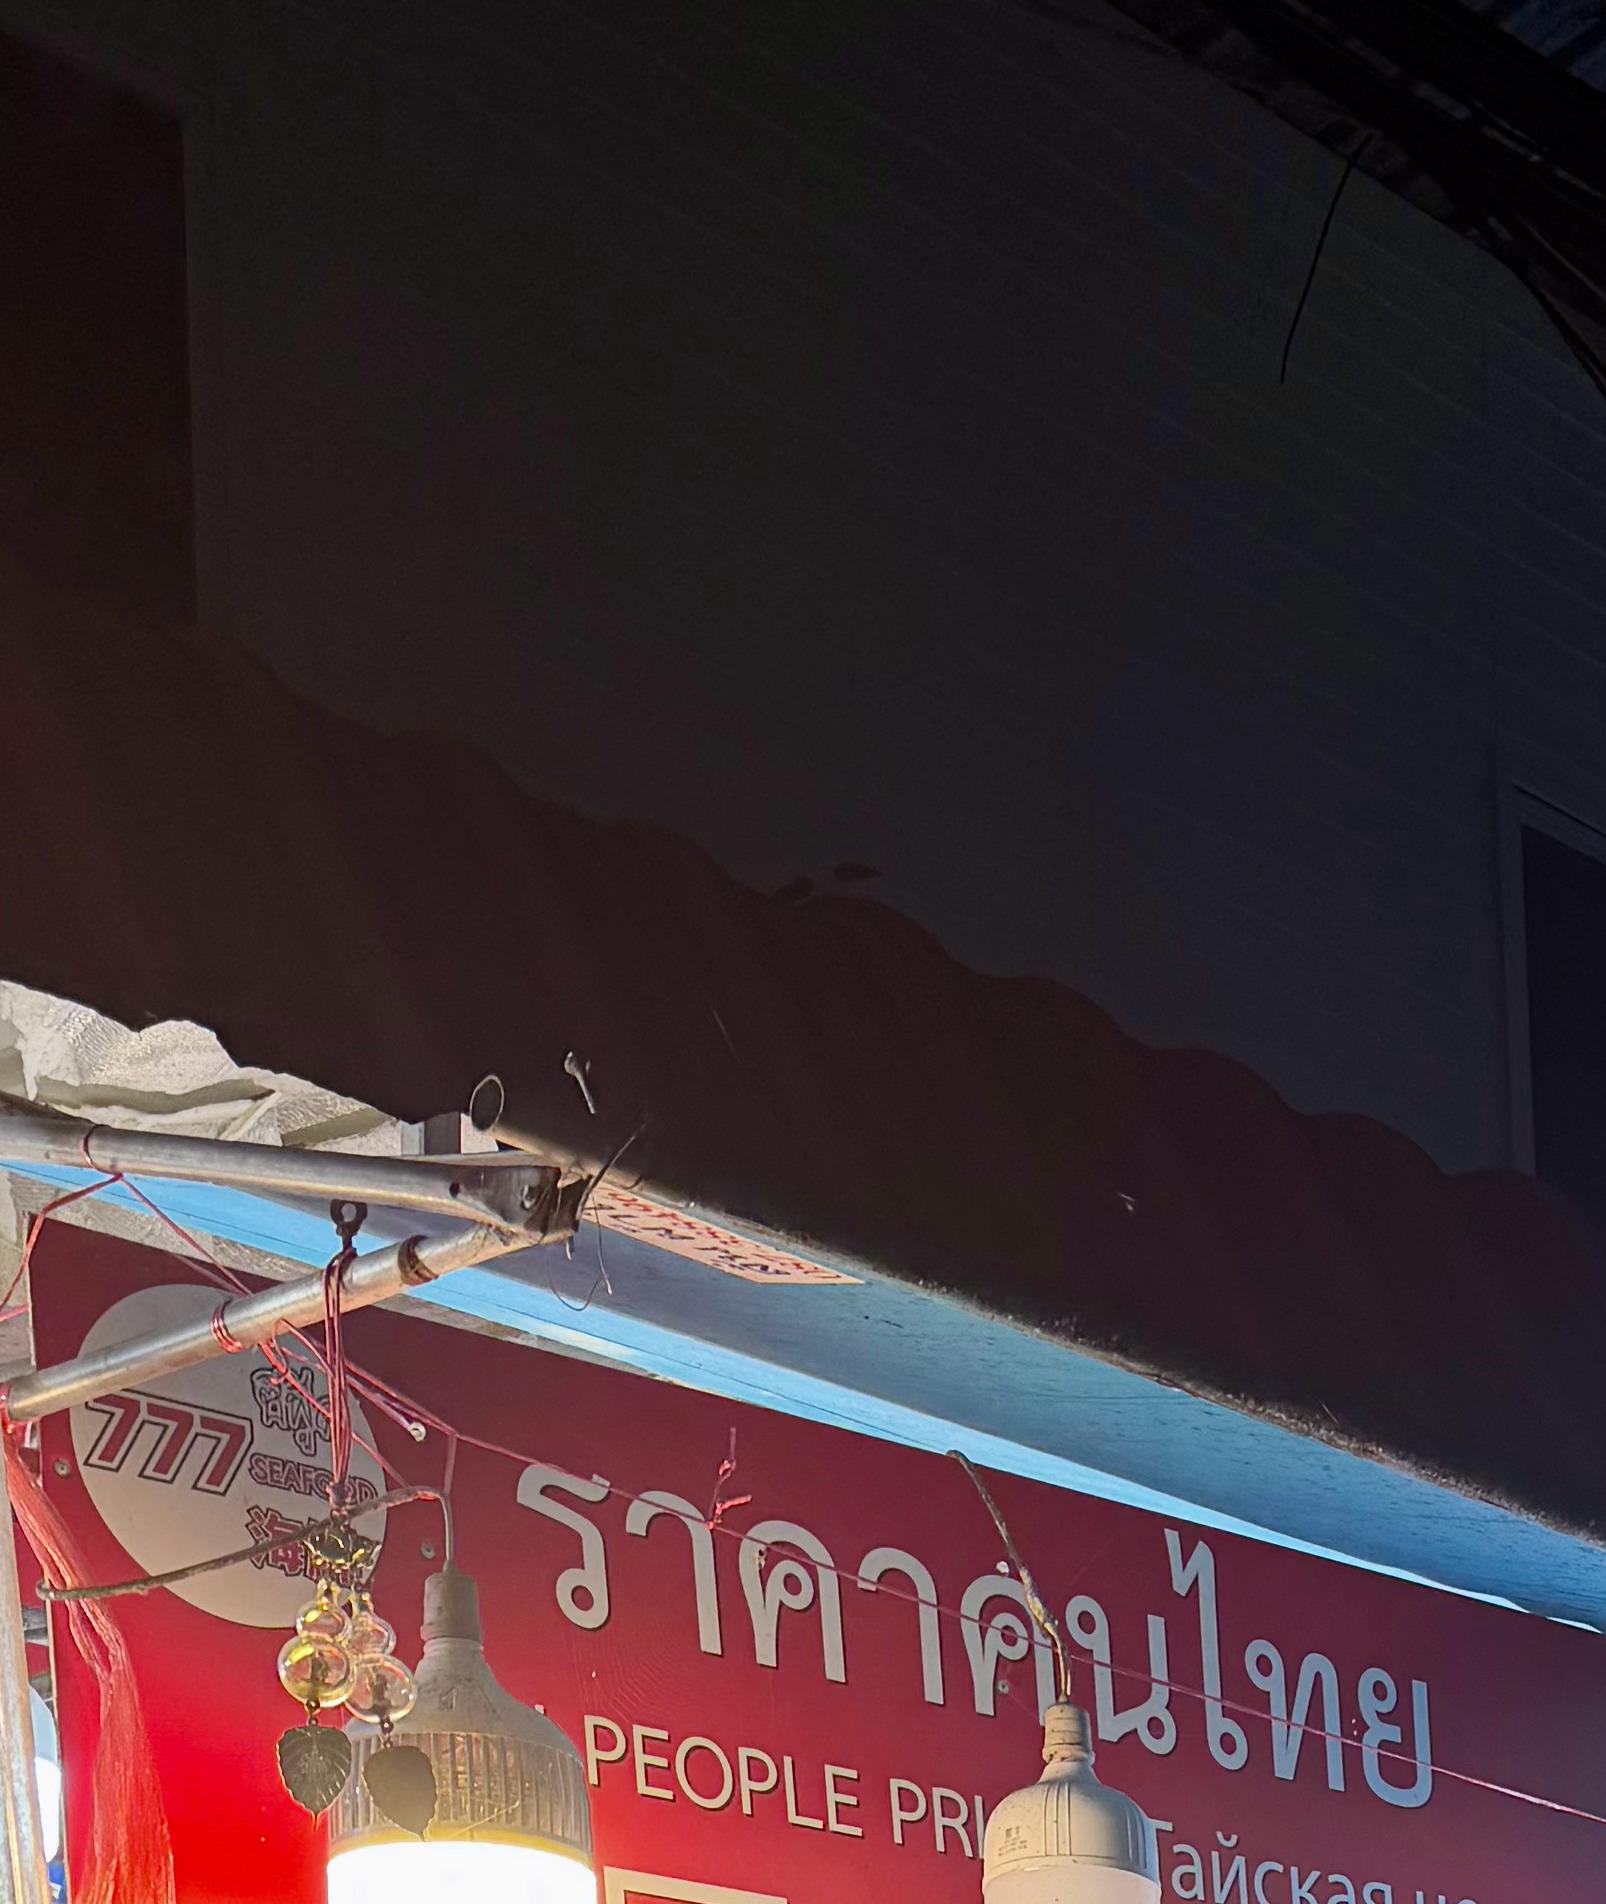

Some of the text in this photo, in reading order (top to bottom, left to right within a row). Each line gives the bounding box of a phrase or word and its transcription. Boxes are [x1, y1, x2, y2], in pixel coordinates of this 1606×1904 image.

[83, 1388, 254, 1496] 777
[248, 1452, 379, 1505] SEAFOD
[516, 1462, 1437, 1809] ราคาคนไทย
[584, 1714, 984, 1861] PEOPLE PRI
